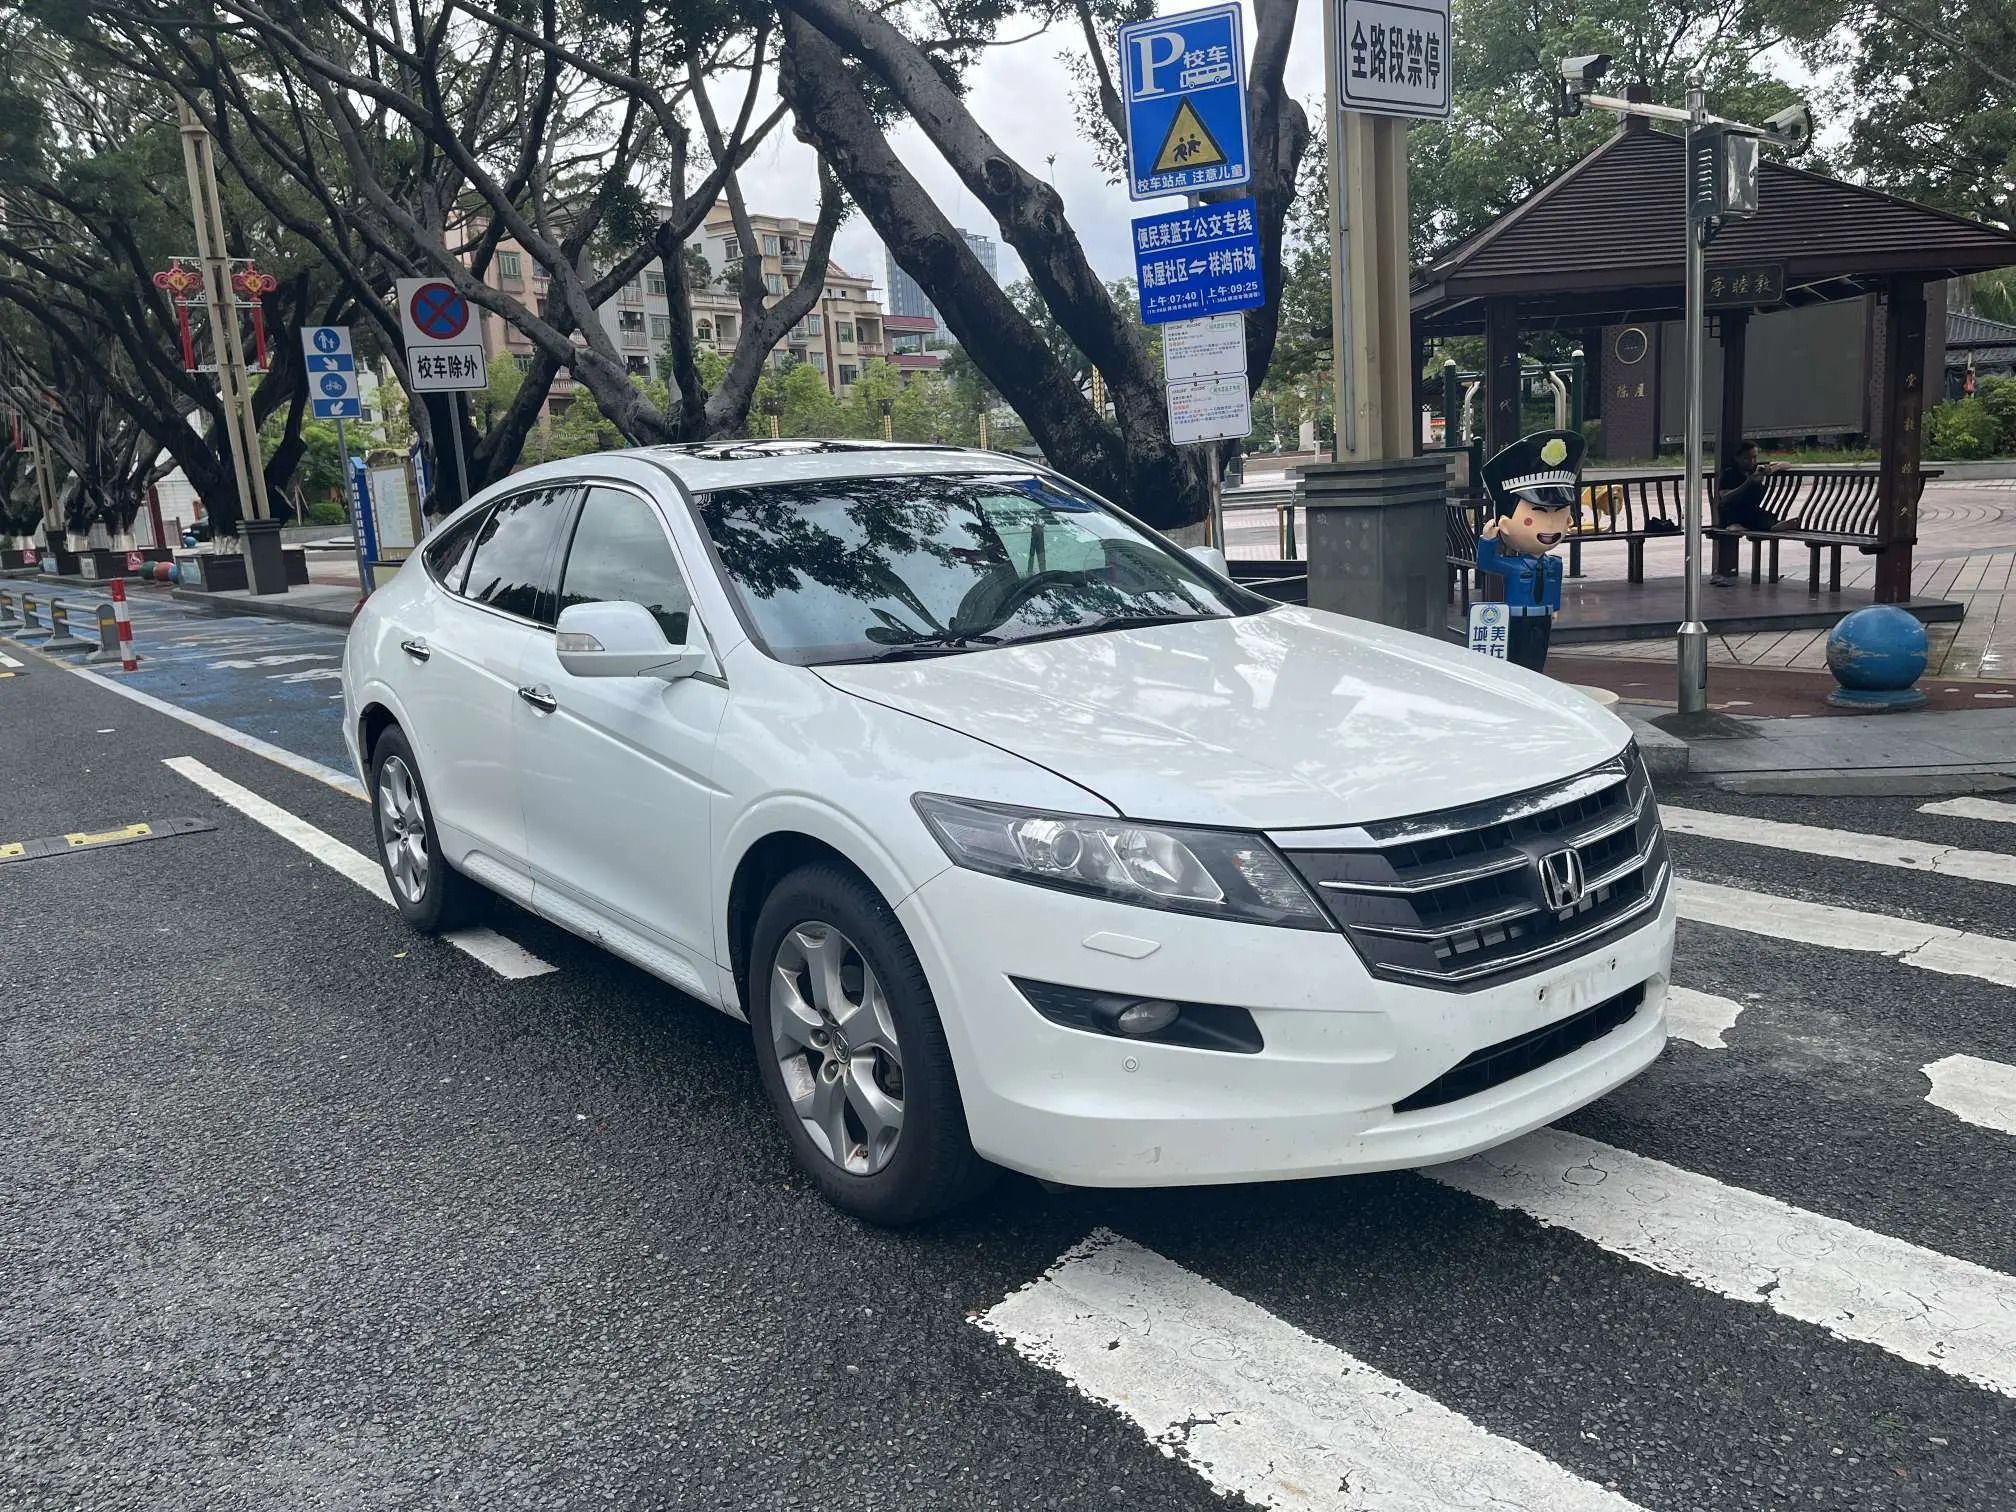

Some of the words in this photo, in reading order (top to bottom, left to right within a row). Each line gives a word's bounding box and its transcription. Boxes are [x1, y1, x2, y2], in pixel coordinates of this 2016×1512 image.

[1130, 31, 1186, 97] P
[1183, 45, 1229, 69] 校车
[1351, 19, 1440, 90] 全路段禁停
[1137, 173, 1187, 192] 校车站点
[1192, 164, 1243, 184] 注意儿童
[1137, 208, 1253, 250] 便民菜篮子公交专线
[1142, 257, 1189, 289] 陈屋社区
[1208, 246, 1256, 278] 祥鸿市场
[418, 354, 478, 379] 校车除外
